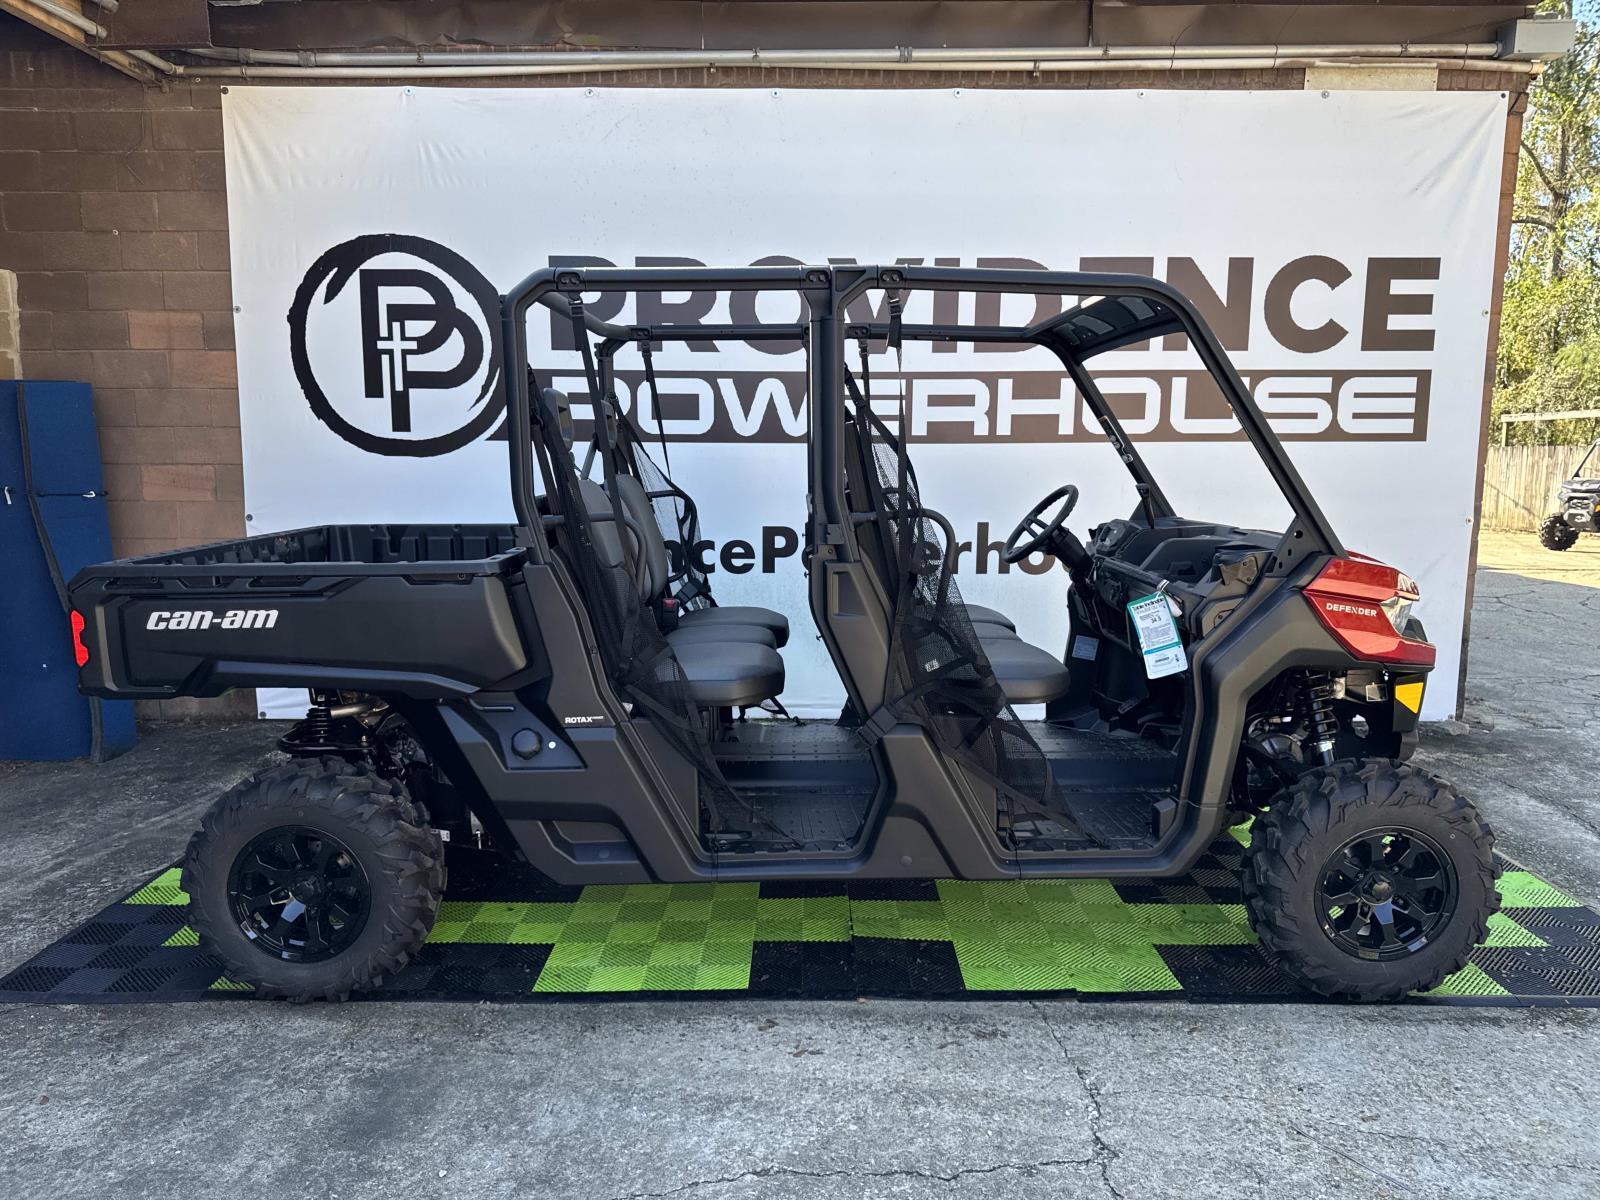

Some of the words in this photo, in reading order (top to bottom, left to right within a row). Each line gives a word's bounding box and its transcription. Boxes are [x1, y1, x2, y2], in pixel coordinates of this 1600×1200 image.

[551, 376, 1418, 437] POWERHOUSE
[1326, 602, 1377, 617] DEFENDER
[146, 609, 279, 630] can-am
[564, 716, 593, 724] ROTAX
